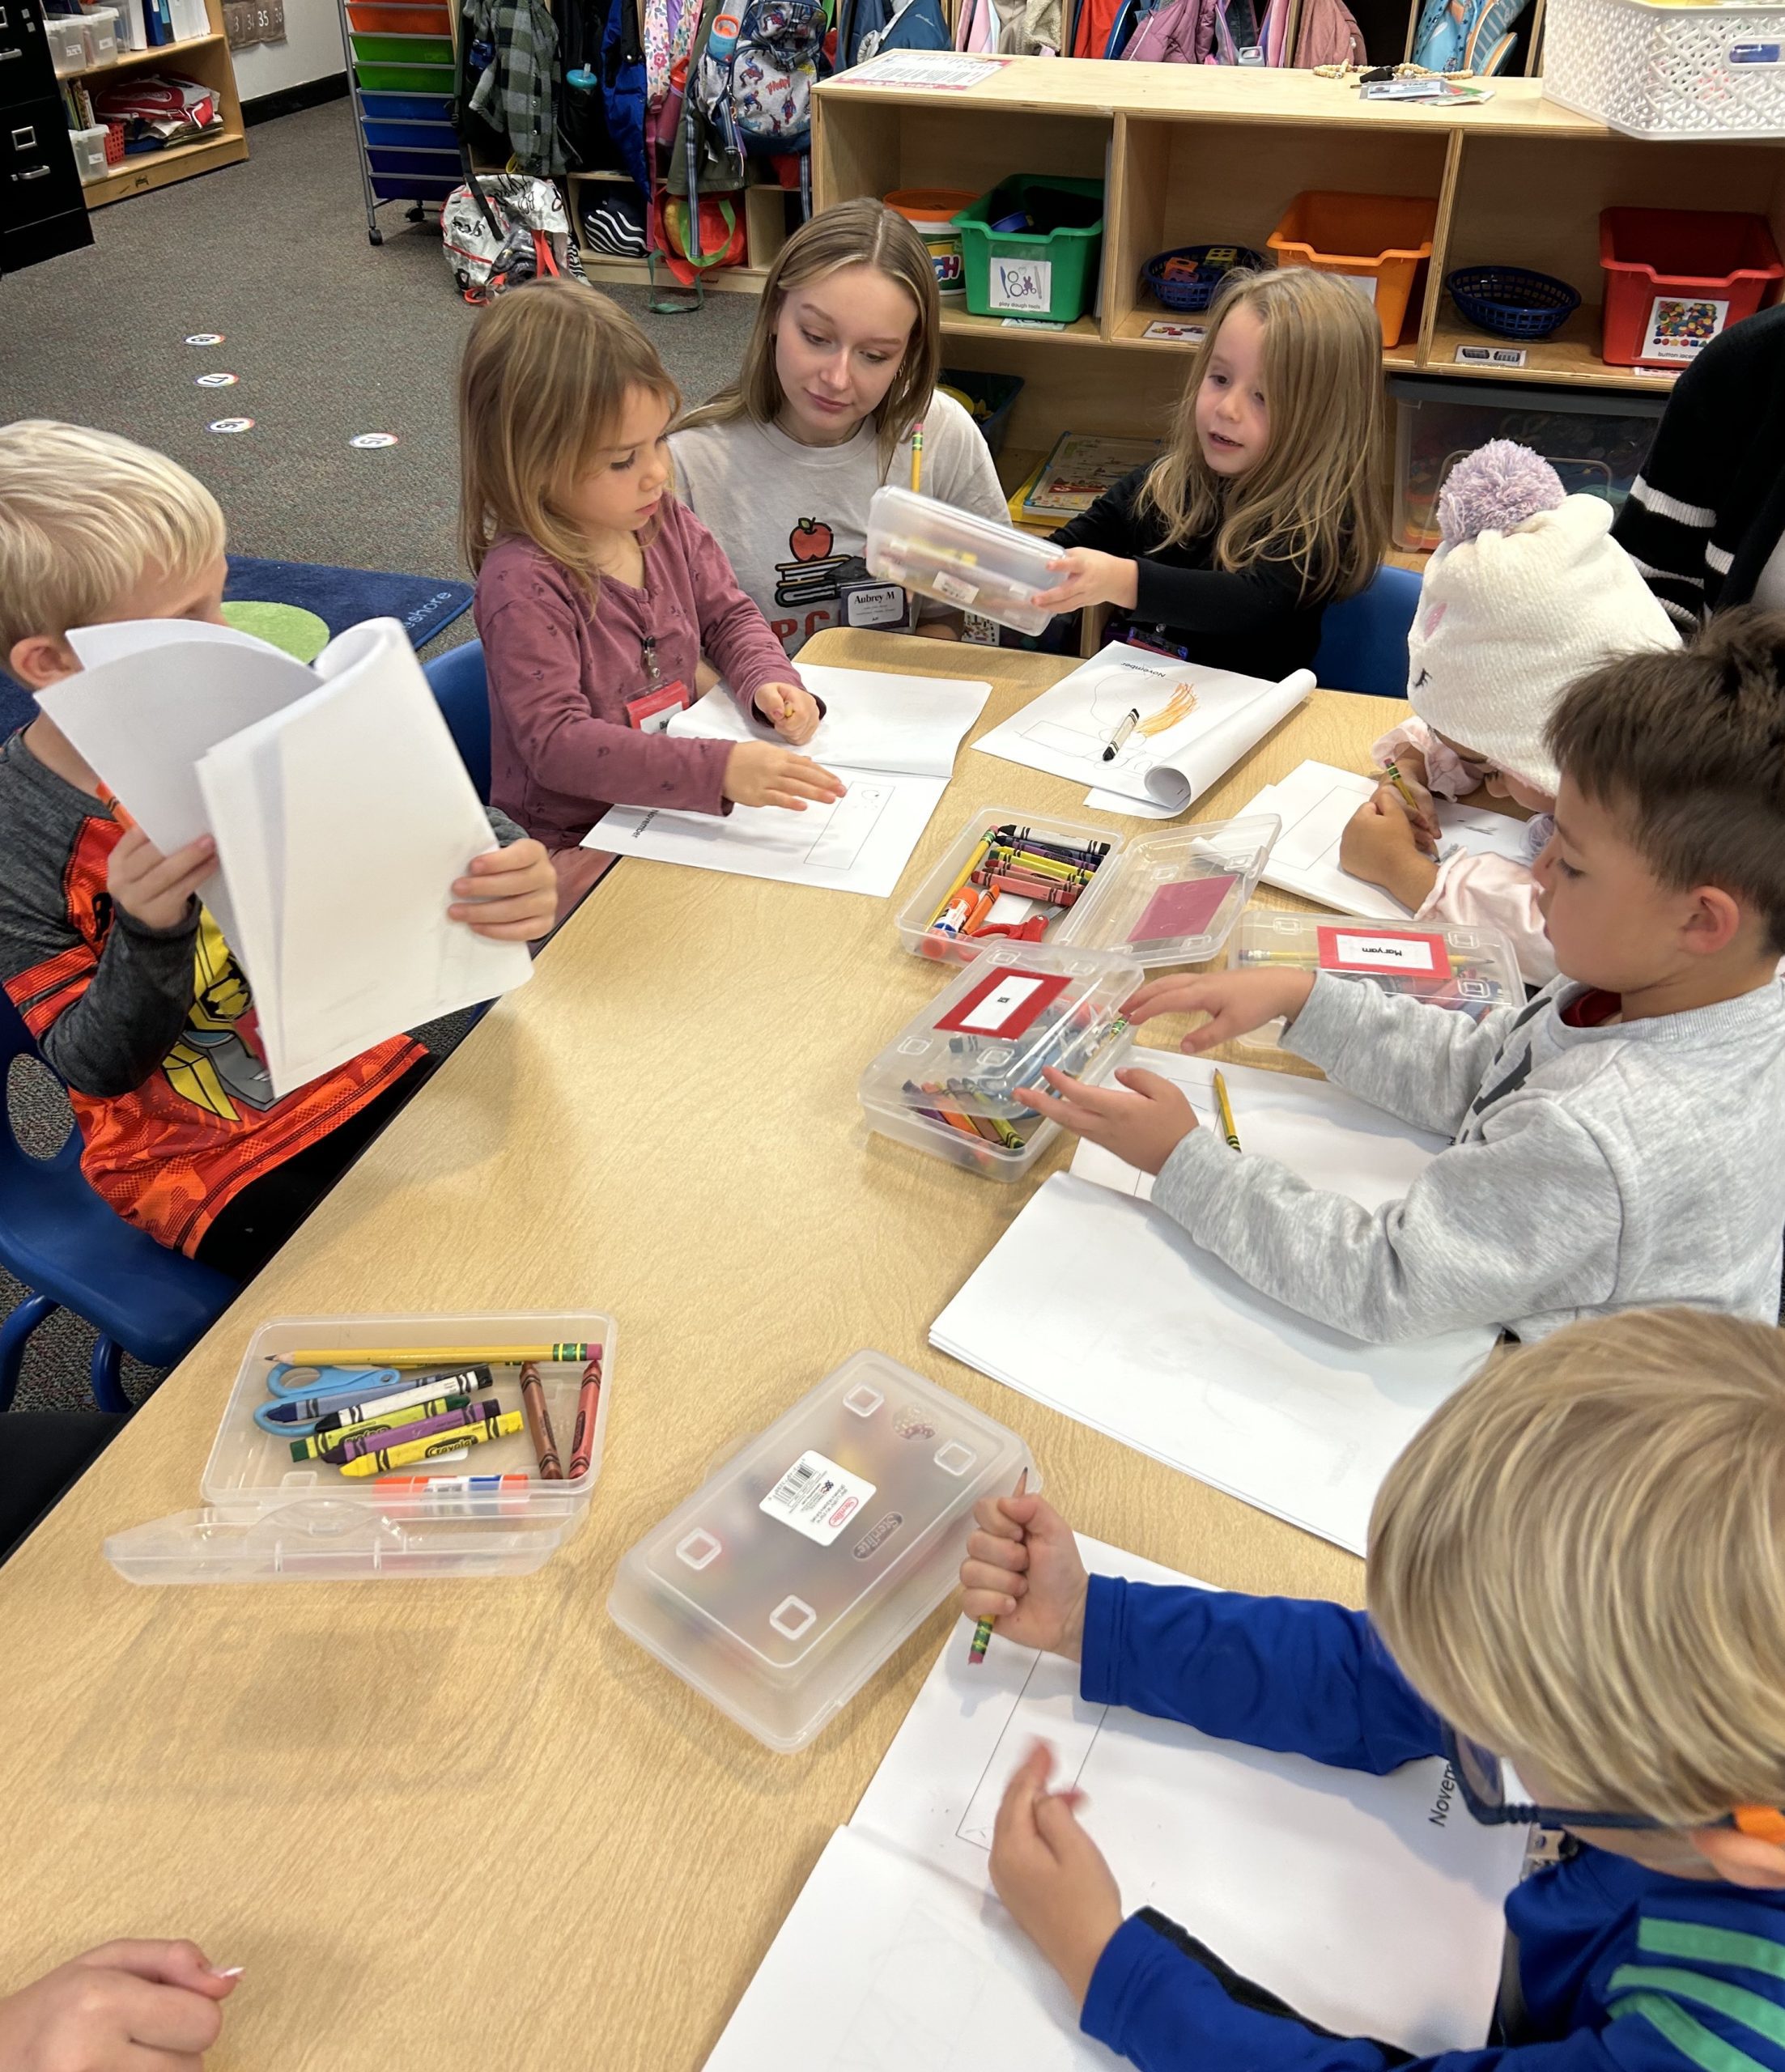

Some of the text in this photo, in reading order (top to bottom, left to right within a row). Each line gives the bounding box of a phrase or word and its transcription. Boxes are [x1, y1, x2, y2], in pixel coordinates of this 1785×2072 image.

[257, 10, 270, 27] 35
[203, 376, 228, 384] 17
[216, 421, 244, 429] 16
[854, 591, 895, 605] Aubrey M
[1120, 662, 1166, 677] November
[631, 809, 659, 838] November
[1362, 947, 1402, 956] Maryam
[833, 1501, 856, 1523] Sterilite
[857, 1514, 899, 1554] Sterilite
